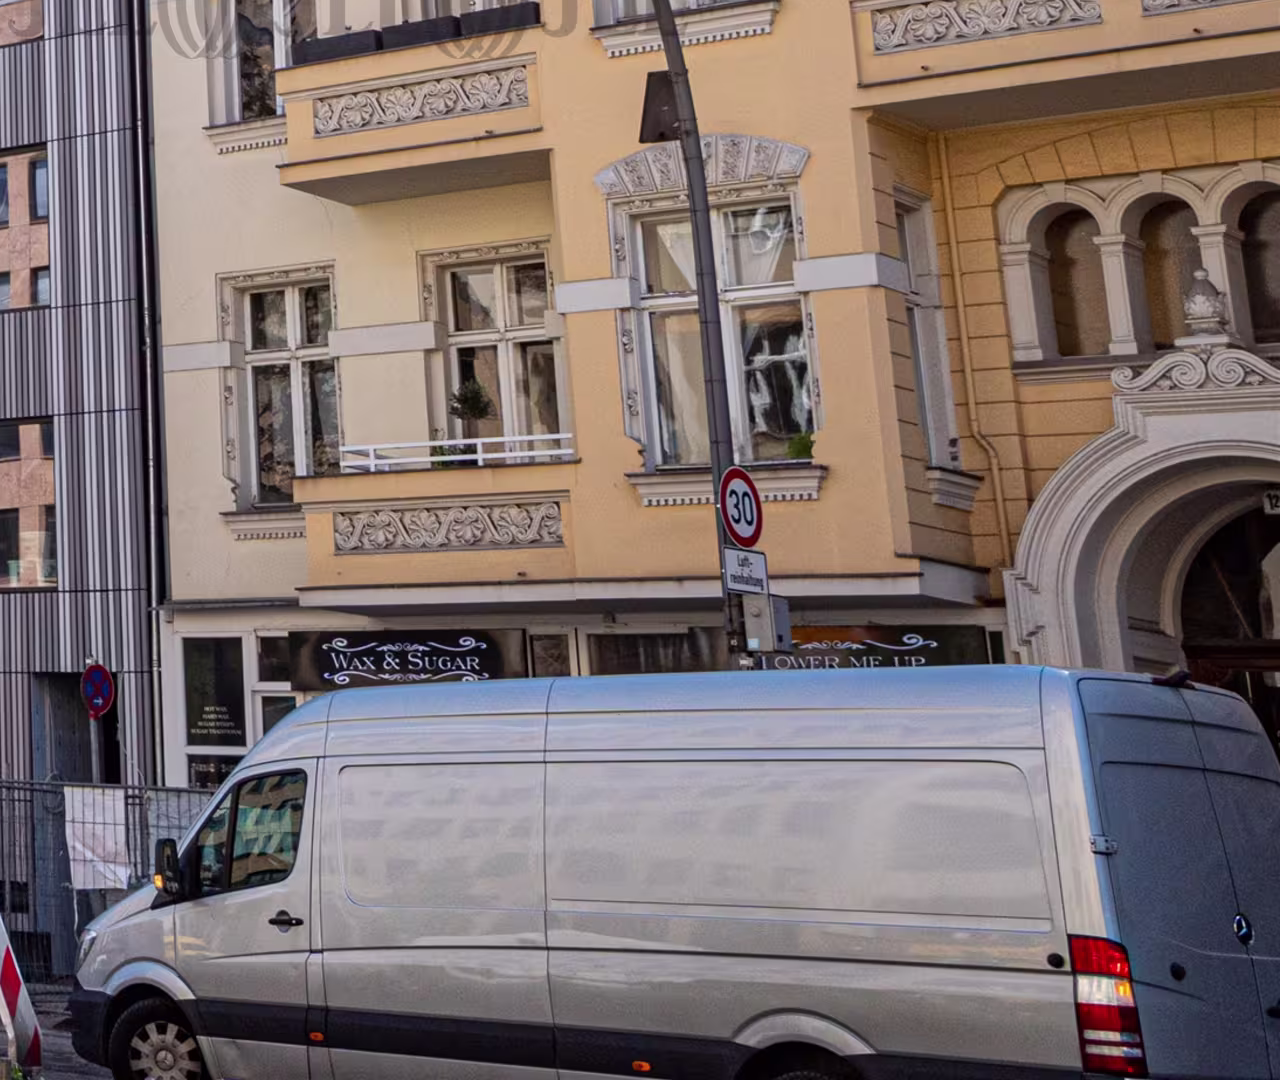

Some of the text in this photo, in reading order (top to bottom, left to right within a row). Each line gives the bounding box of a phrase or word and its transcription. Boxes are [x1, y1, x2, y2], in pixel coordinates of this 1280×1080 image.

[728, 488, 754, 527] 30
[382, 652, 401, 670] &
[849, 656, 883, 668] ME
[894, 656, 926, 668] UP
